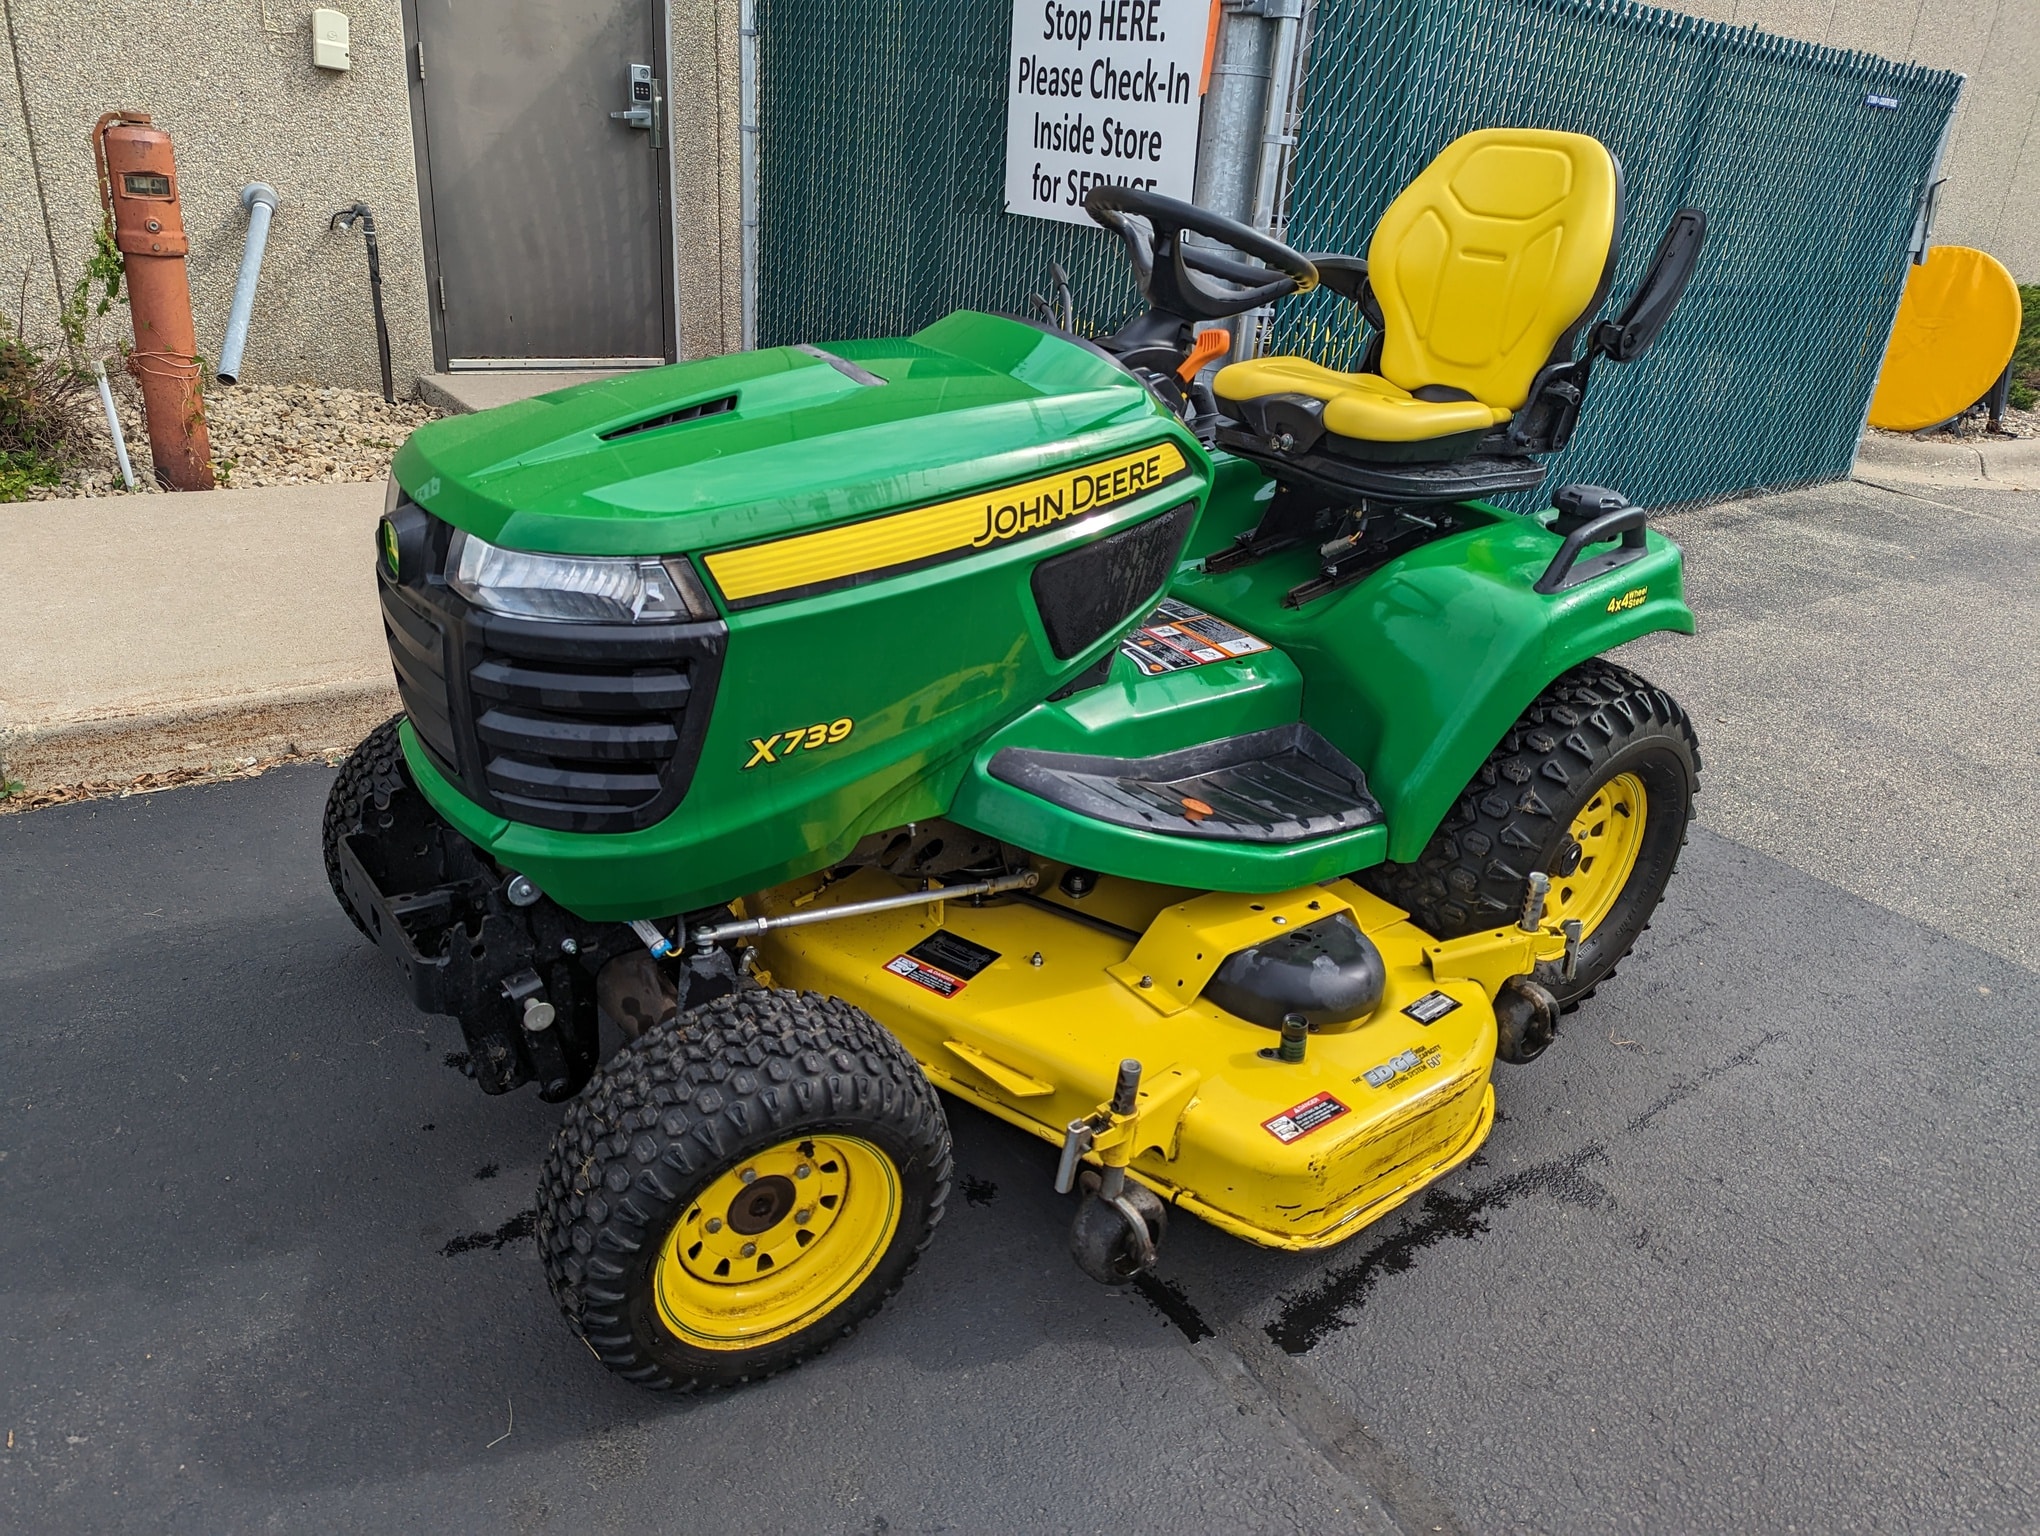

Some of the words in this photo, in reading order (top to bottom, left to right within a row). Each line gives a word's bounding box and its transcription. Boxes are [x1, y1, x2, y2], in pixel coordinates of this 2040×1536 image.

[1043, 1, 1092, 51] Stop
[1098, 0, 1166, 42] HERE.
[1018, 54, 1083, 98] Please
[1090, 57, 1190, 104] Check-In
[1033, 112, 1095, 154] Inside
[1100, 117, 1162, 162] Store
[1032, 162, 1061, 203] for
[974, 489, 1063, 543] JOHN
[1072, 454, 1161, 511] DEERE
[1607, 593, 1629, 613] 4x4
[1628, 596, 1646, 608] Steer
[1630, 586, 1648, 599] Wheel
[743, 717, 854, 769] X739
[1362, 1047, 1422, 1089] EDGE
